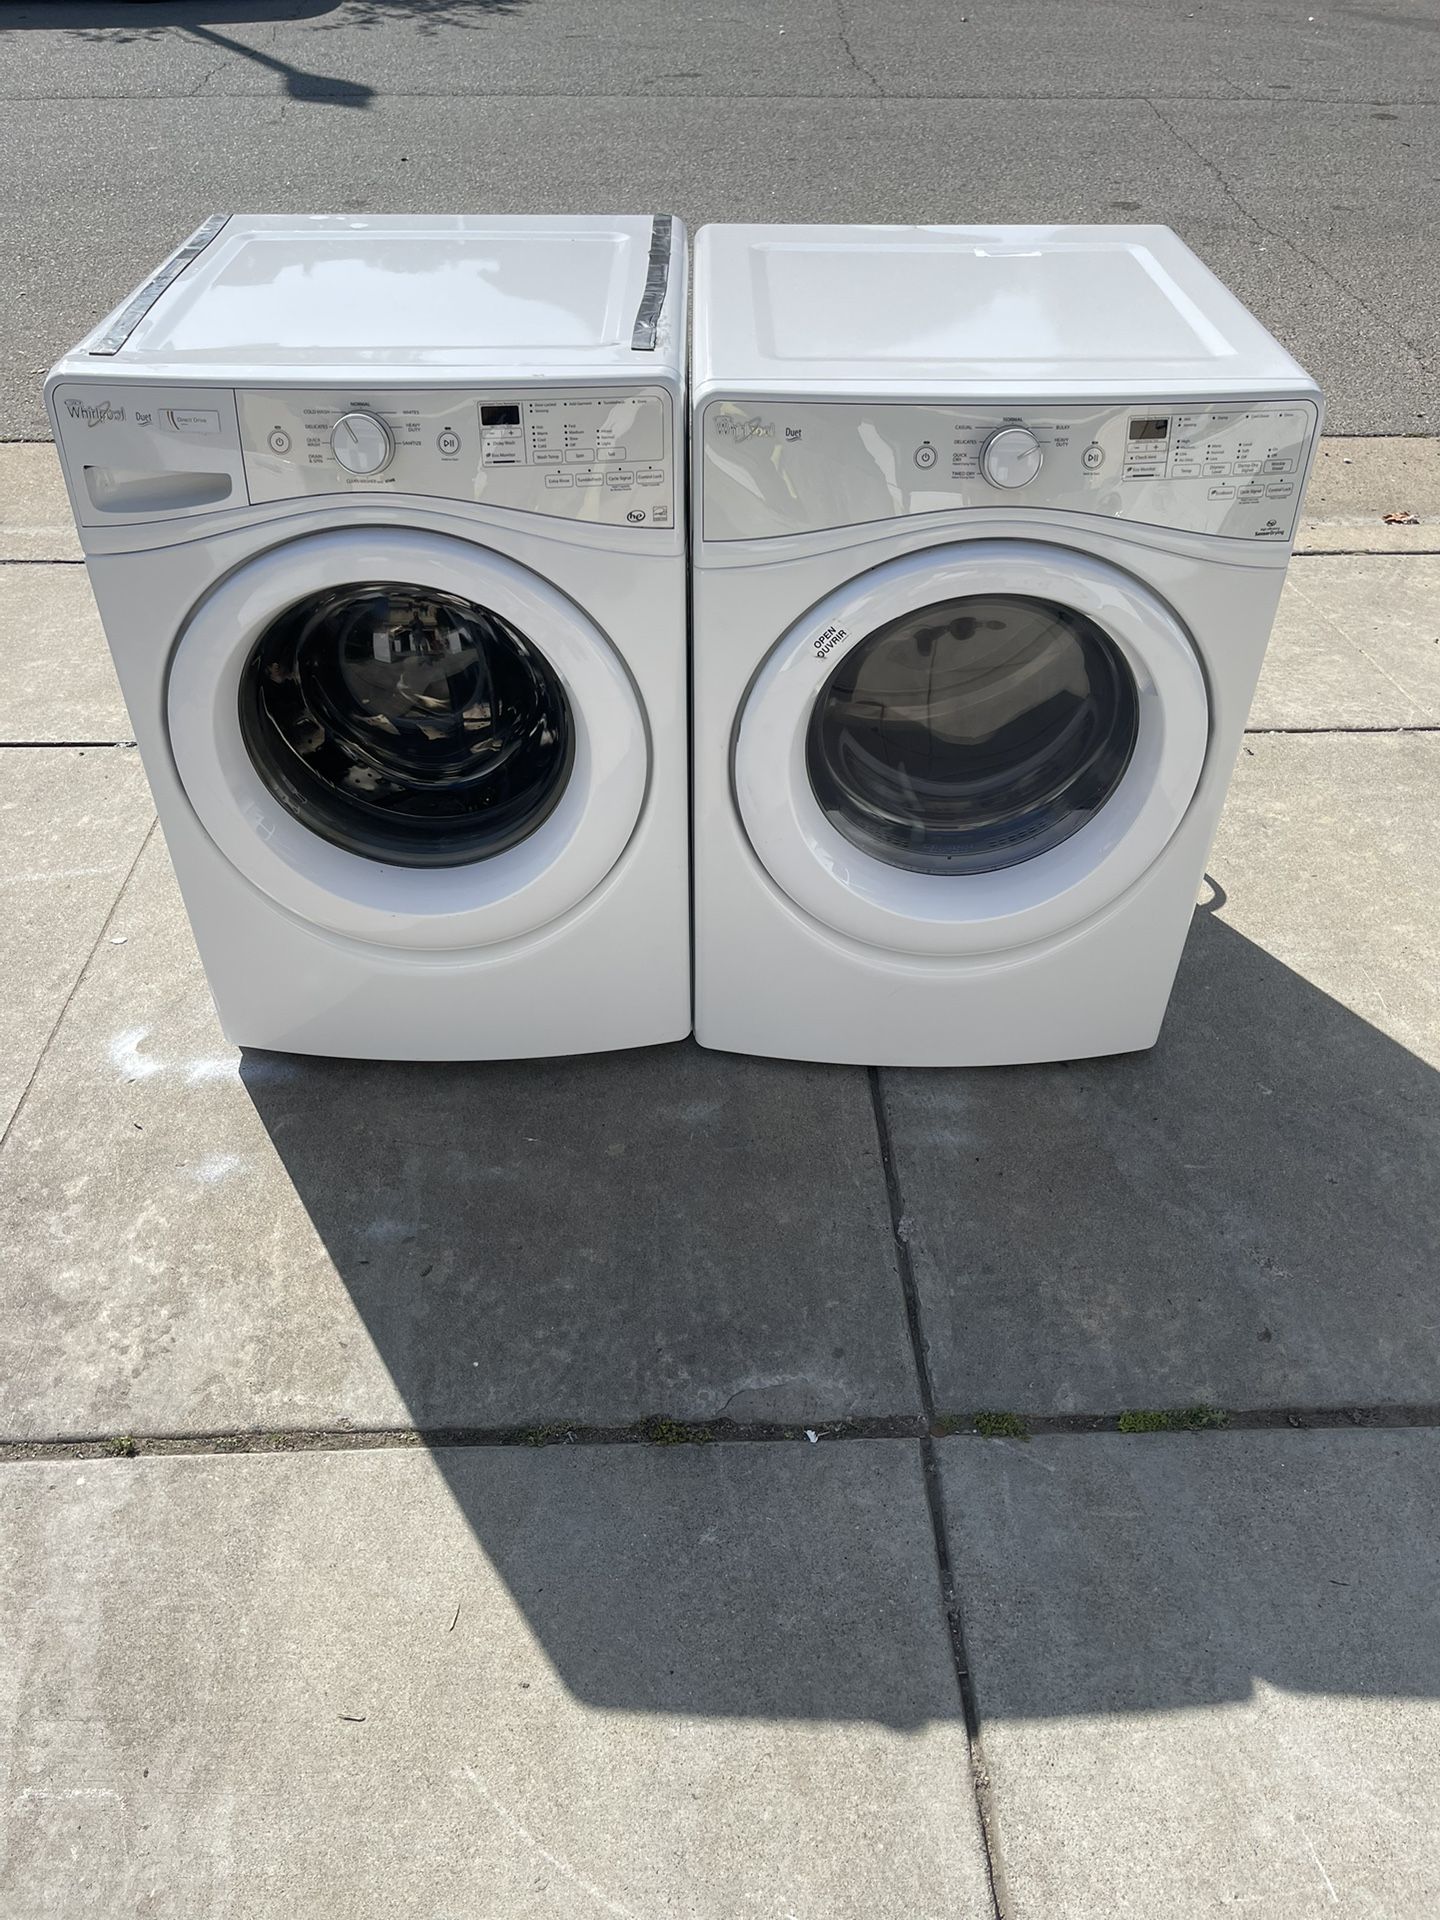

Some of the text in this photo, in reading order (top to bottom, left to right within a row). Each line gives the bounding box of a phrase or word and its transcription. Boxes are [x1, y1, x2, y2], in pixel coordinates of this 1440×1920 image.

[136, 412, 152, 422] Duet
[786, 427, 802, 437] Duet
[813, 626, 836, 648] OPEN
[817, 629, 847, 658] OUVRIR
